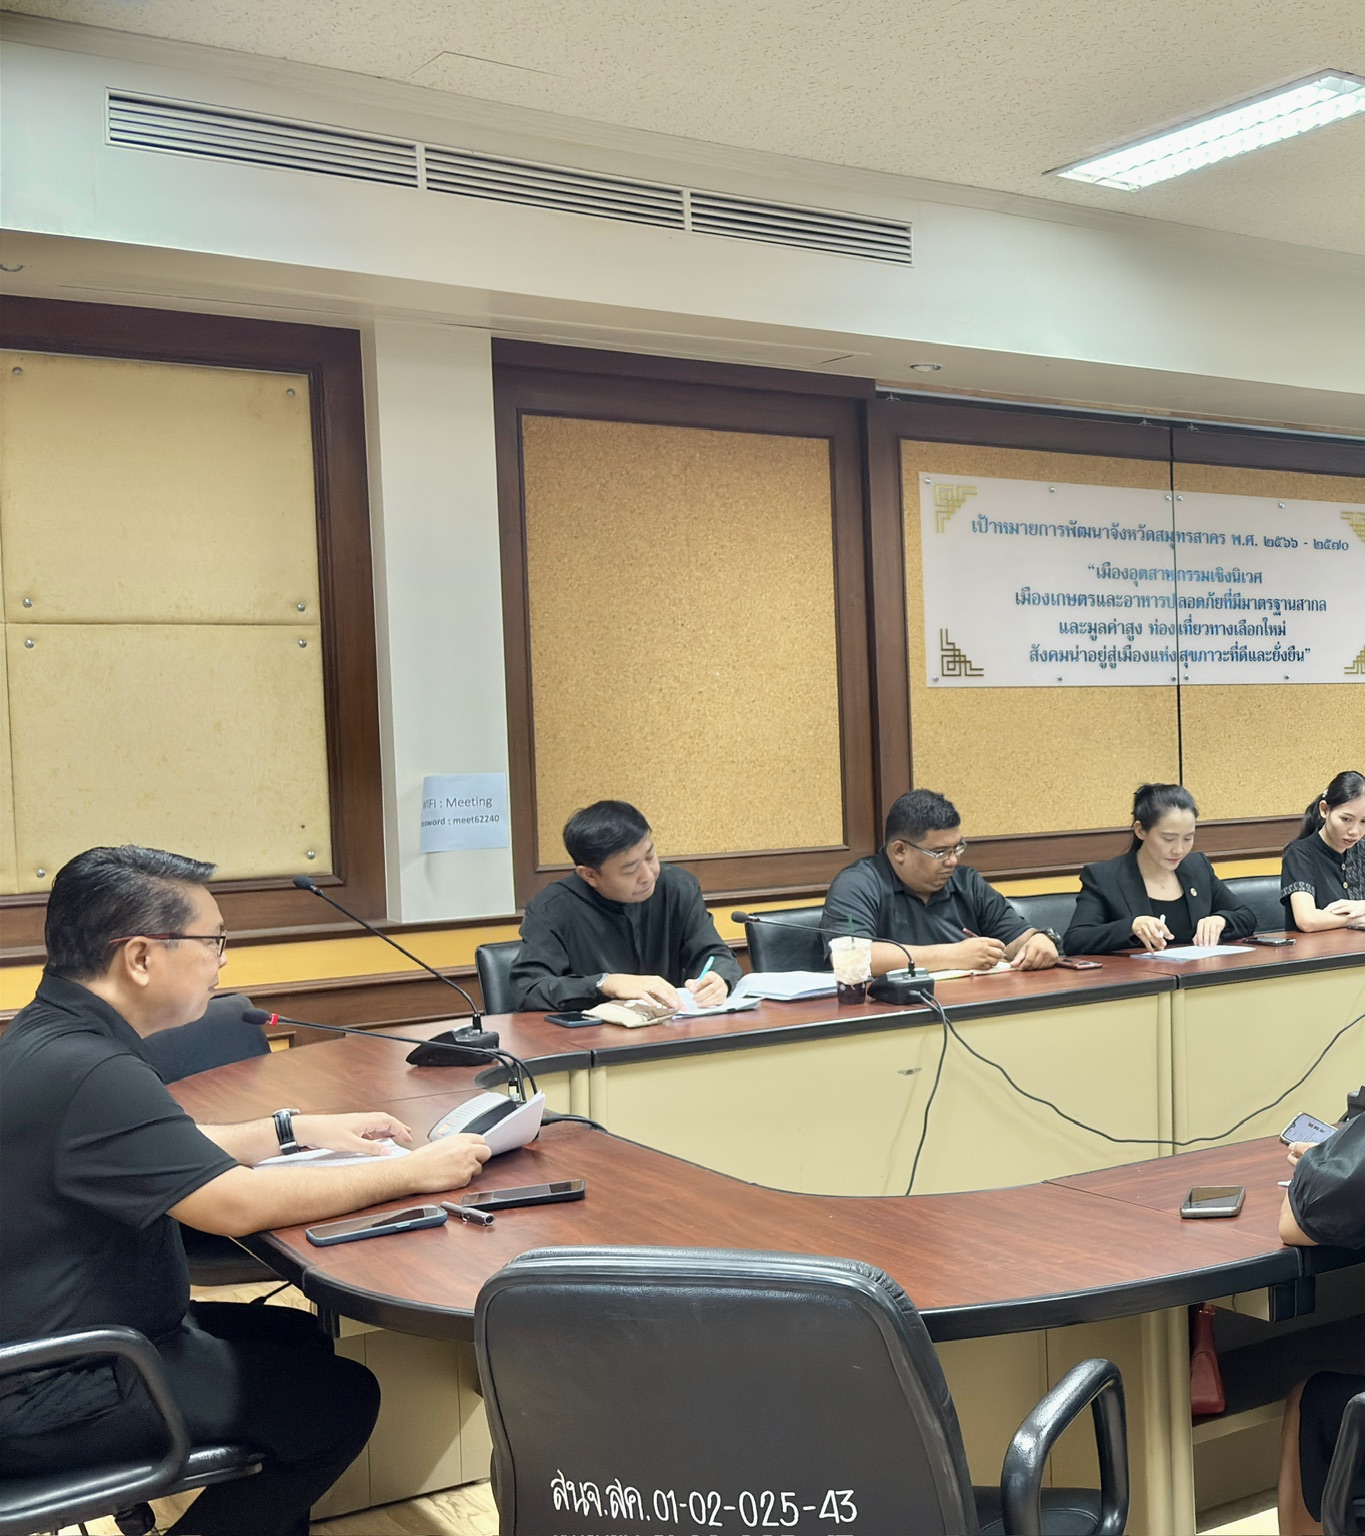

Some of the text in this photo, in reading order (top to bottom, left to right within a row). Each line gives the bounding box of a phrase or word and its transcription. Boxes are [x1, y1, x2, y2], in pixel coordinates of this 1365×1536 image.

[971, 513, 1227, 550] เป้าหมายการพัฒนาจังหวัดสมุทรสาคร
[1231, 533, 1259, 547] พ.ศ.
[1263, 535, 1299, 549] ๒๕๖๖
[1313, 537, 1350, 551] ๒๕๗๐
[1015, 586, 1328, 616] เมืองเกษตรและอาหารปลอดภัยที่มีมาตรฐานสากล
[1059, 614, 1287, 642] และมูลค่าสูง ท่องเที่ยวทางเลือกใหม่
[446, 796, 493, 809] Meeting
[453, 814, 500, 826] meet62240
